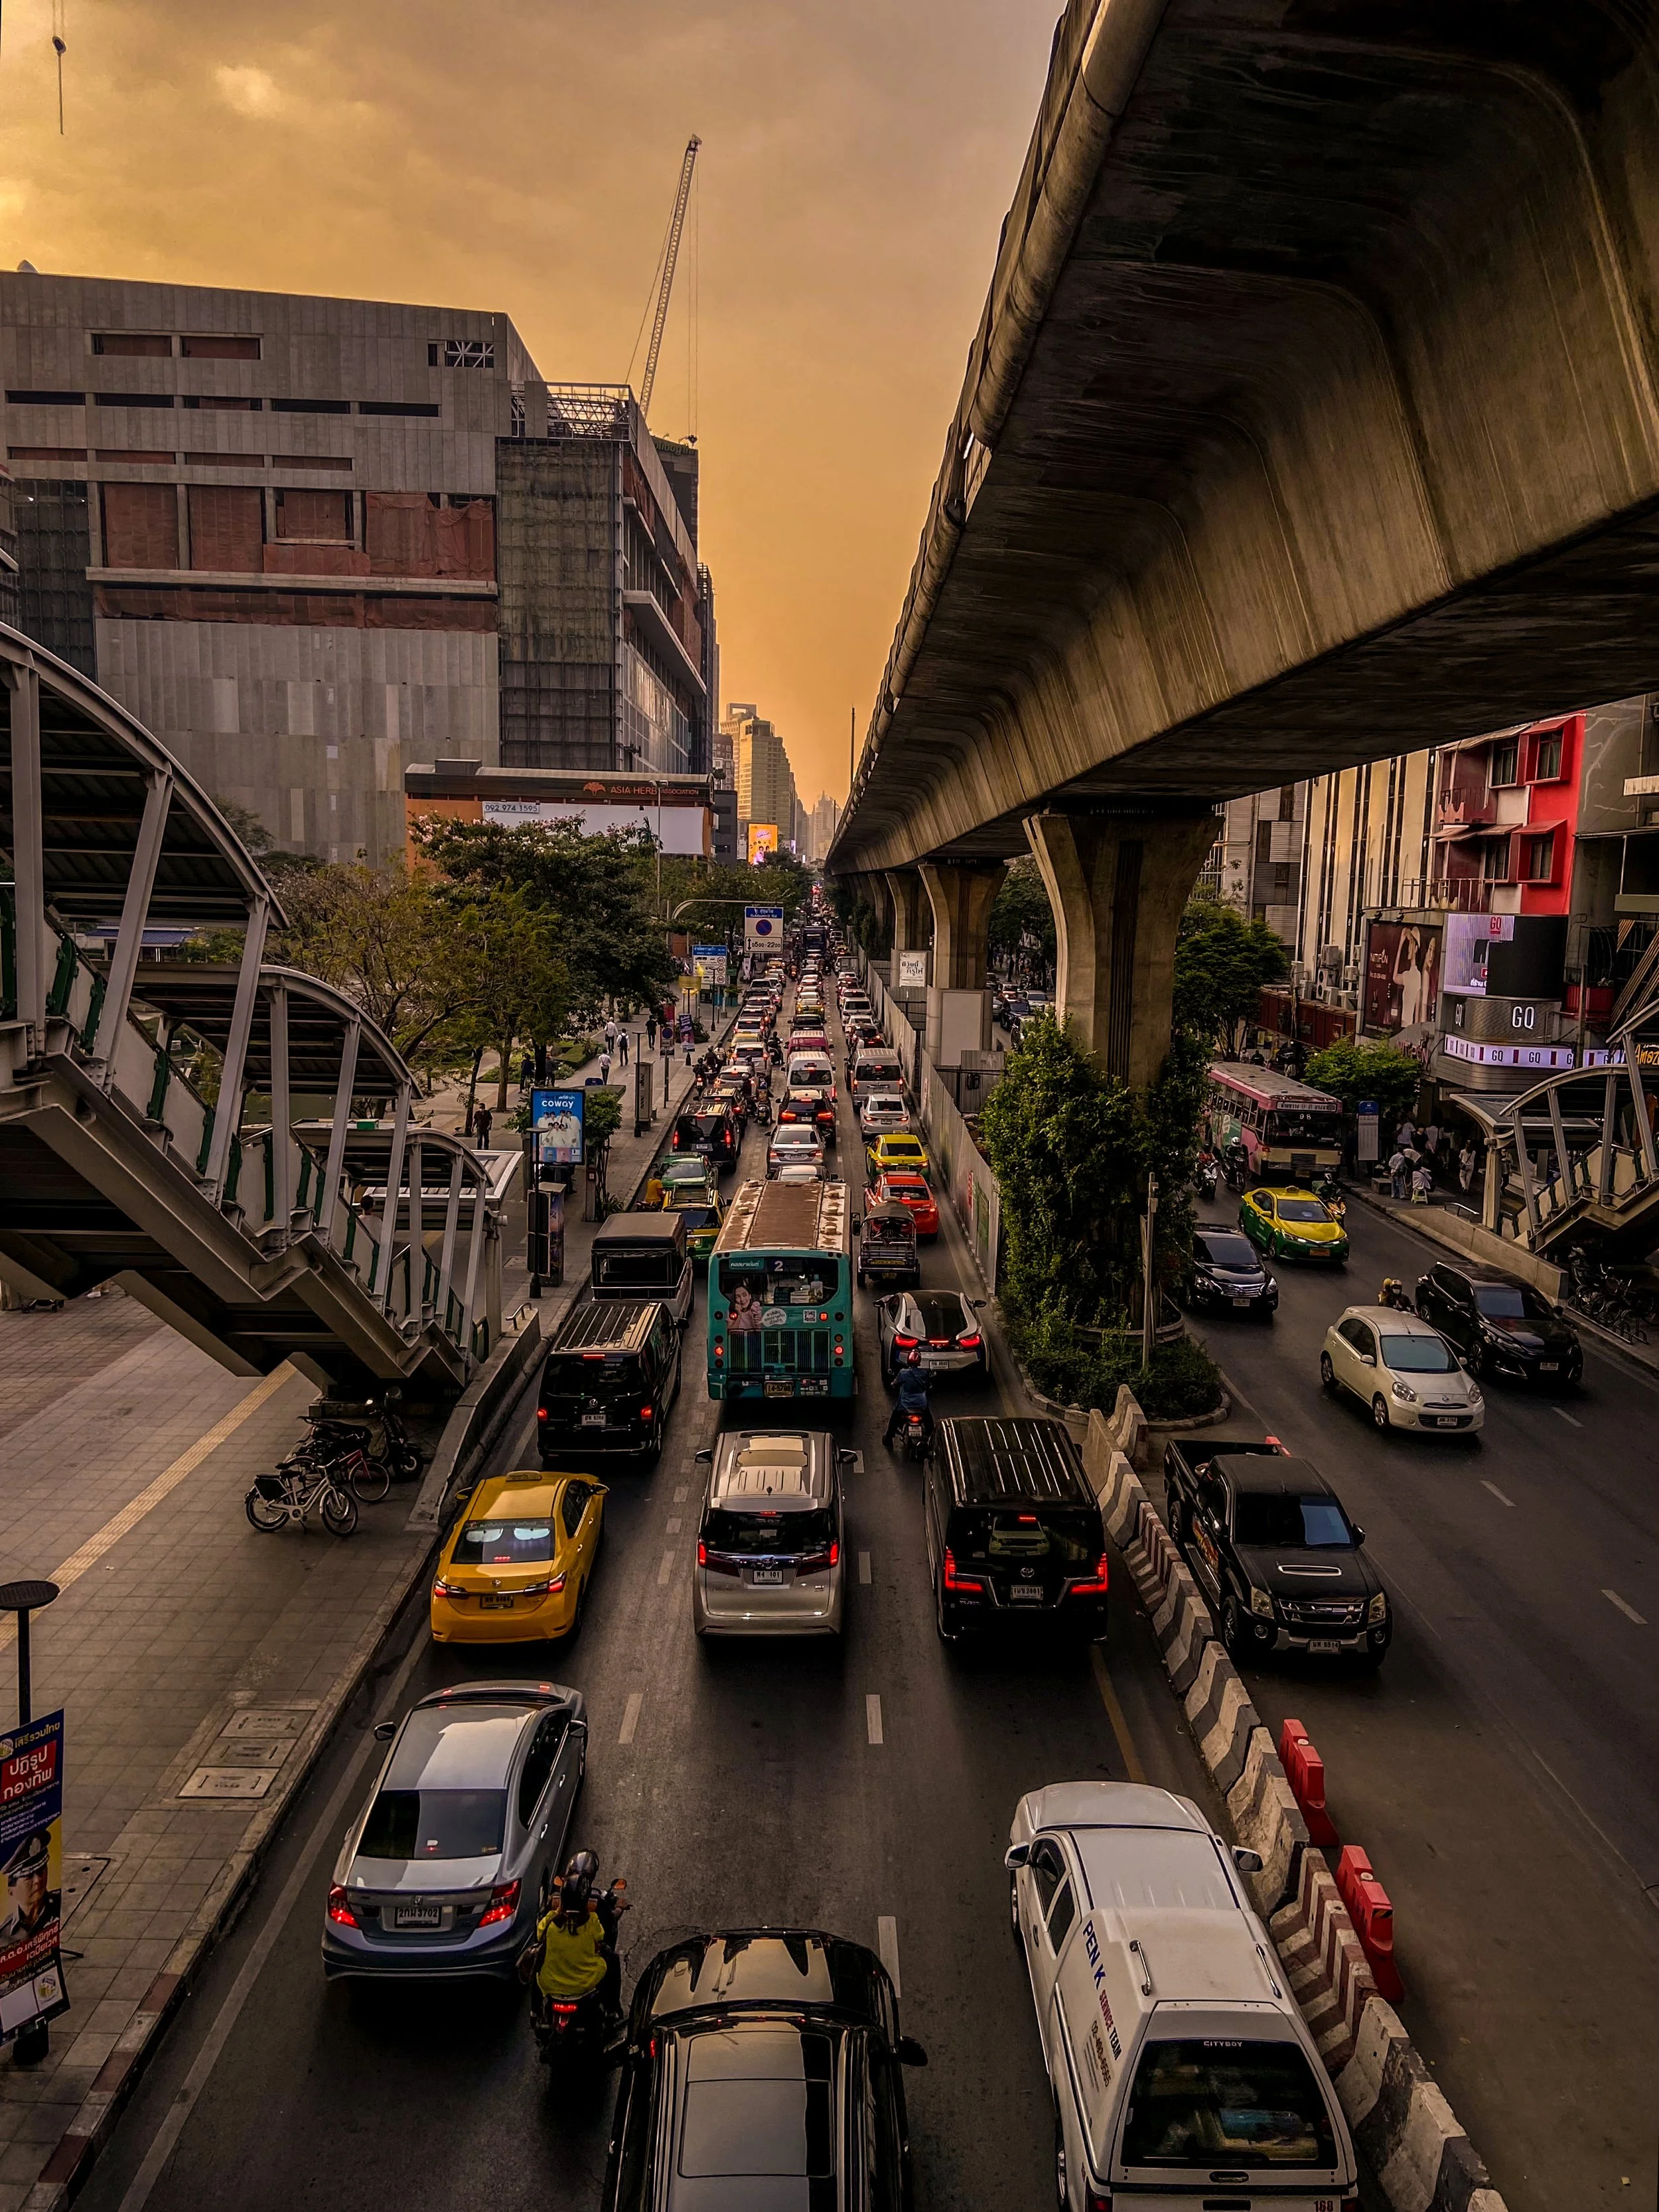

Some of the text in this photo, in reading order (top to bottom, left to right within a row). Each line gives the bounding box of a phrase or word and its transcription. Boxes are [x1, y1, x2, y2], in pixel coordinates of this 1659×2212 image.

[611, 786, 630, 794] ASIA
[633, 786, 656, 795] HERB
[1490, 916, 1501, 930] GQ
[1512, 1006, 1535, 1030] GQ
[1492, 1050, 1503, 1062] GQ
[1528, 1052, 1541, 1063] GQ
[541, 1100, 574, 1109] coway
[774, 1260, 783, 1272] 2
[4, 1767, 52, 1800] กองทัพ
[418, 1908, 438, 1917] 3702
[1083, 1919, 1122, 2061] PEN K SERVICE TEAM
